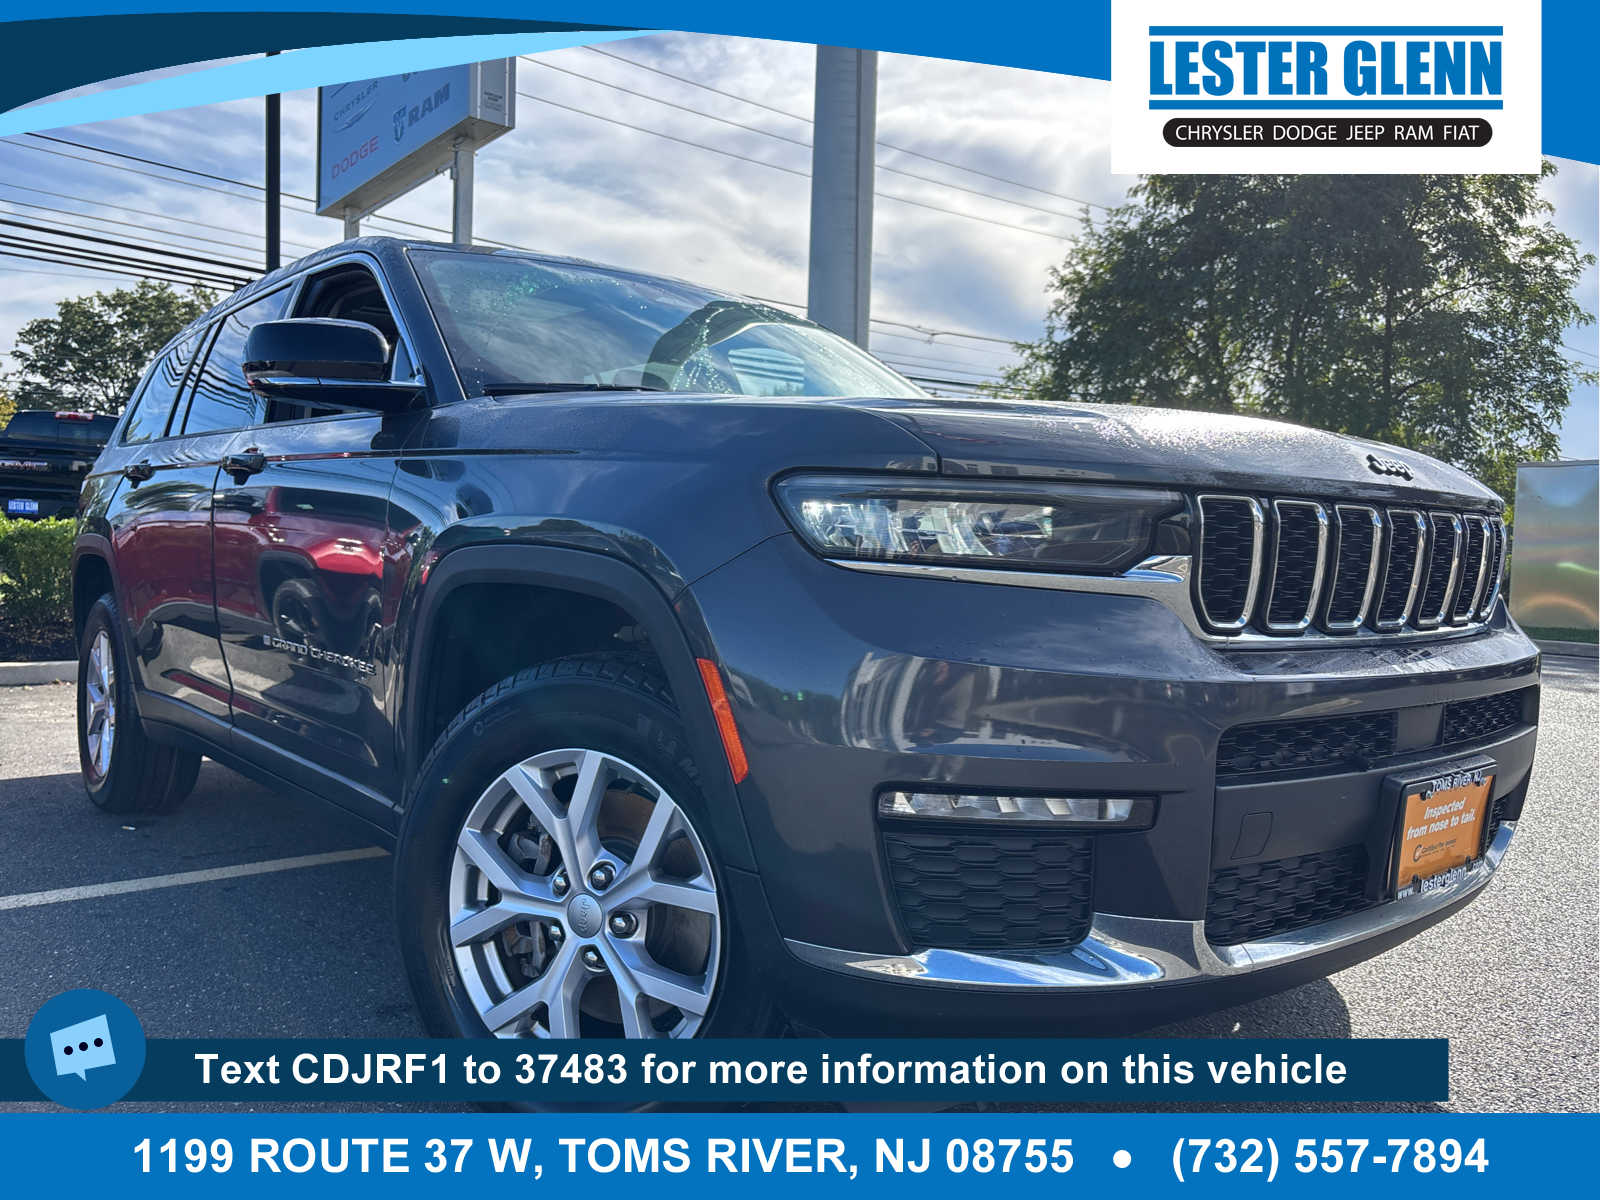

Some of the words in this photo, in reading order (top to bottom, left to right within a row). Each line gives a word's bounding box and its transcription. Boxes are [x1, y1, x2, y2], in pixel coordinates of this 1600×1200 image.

[407, 82, 451, 128] RAM
[331, 136, 380, 180] DODGE
[1366, 454, 1414, 481] Jeep
[271, 637, 308, 656] GRAND
[310, 647, 377, 676] CHEROKEE
[1432, 776, 1453, 793] TOMS
[1424, 797, 1466, 820] Inspected
[1406, 825, 1428, 840] from
[1428, 818, 1449, 833] nose
[1450, 815, 1460, 828] to
